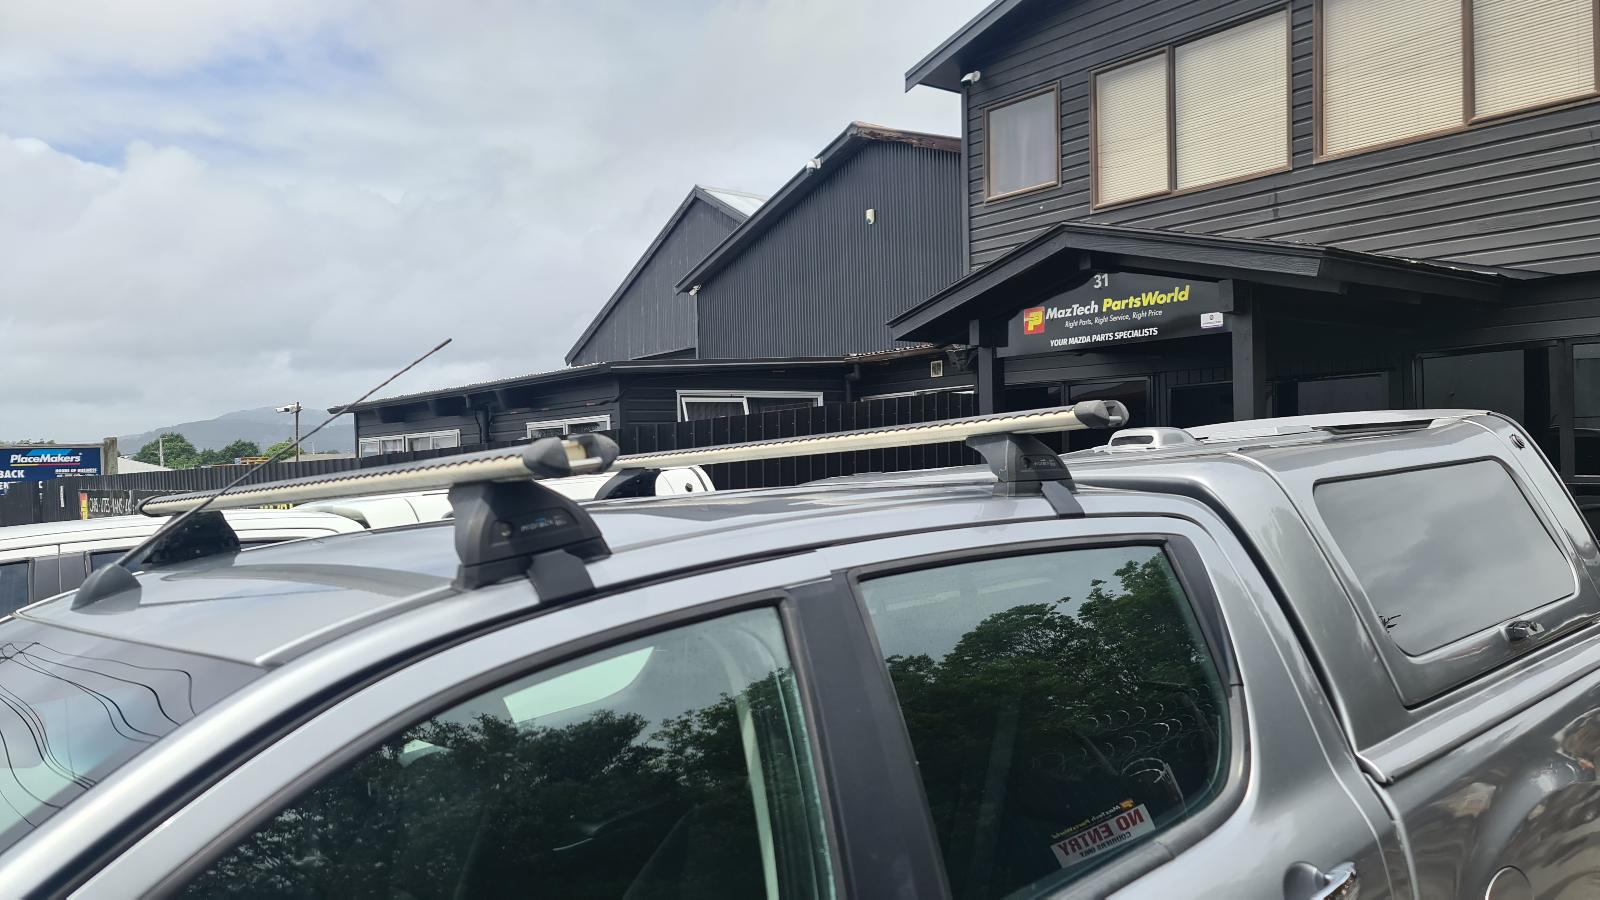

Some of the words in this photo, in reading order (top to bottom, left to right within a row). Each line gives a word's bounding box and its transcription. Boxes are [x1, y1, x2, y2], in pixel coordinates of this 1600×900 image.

[1093, 273, 1109, 289] 31
[1046, 301, 1099, 320] MazTech
[1102, 285, 1191, 313] PartsWorld
[1065, 319, 1078, 329] Right
[1095, 316, 1109, 325] Right
[1109, 314, 1131, 322] Service,
[1132, 311, 1147, 321] Right
[1148, 309, 1163, 317] Price
[1050, 338, 1068, 347] YOUR
[1068, 335, 1091, 345] MAZDA
[1092, 333, 1114, 342] PARTS
[1114, 327, 1158, 340] SPECIALISTS
[10, 453, 81, 463] PlaceMakers
